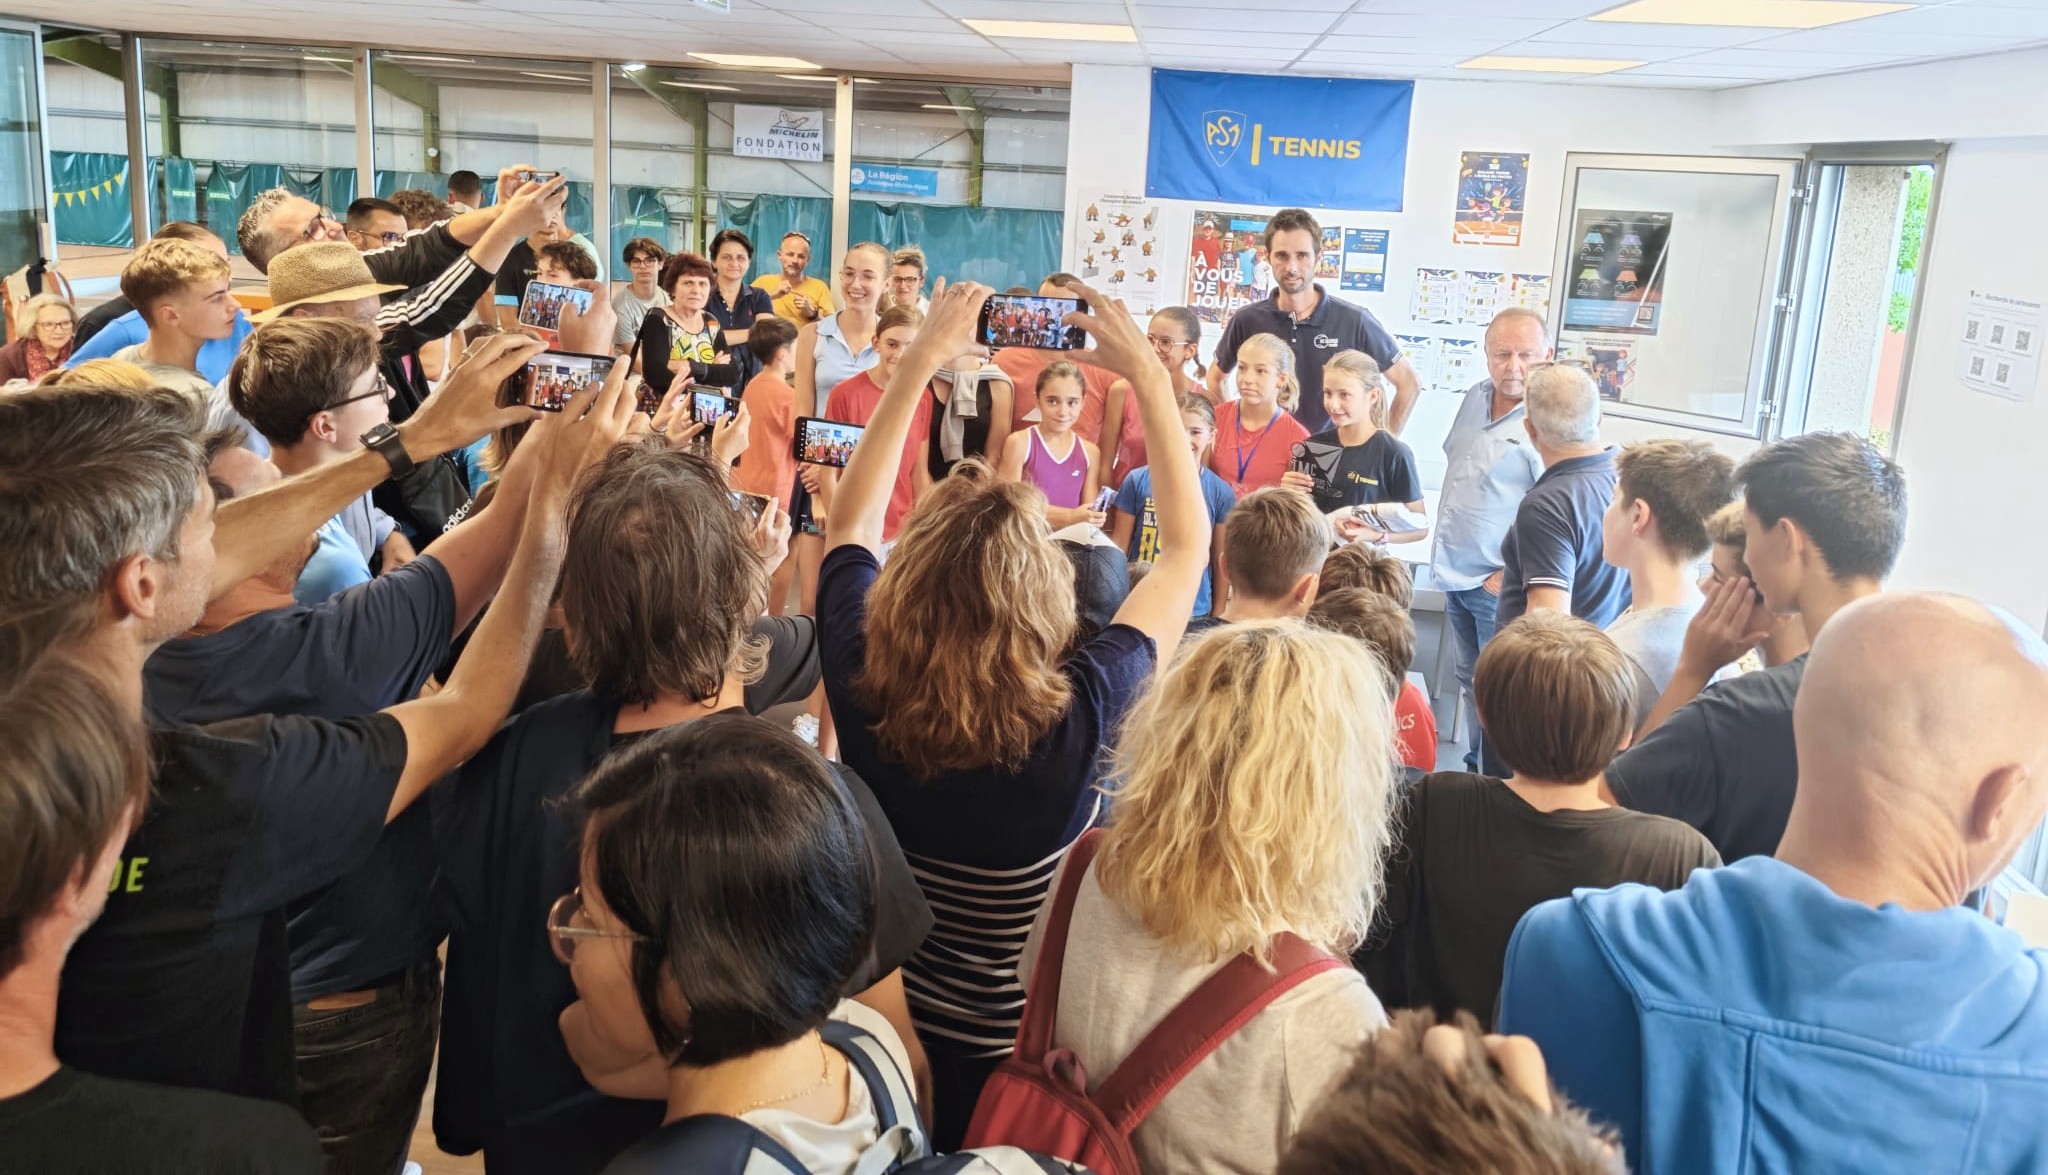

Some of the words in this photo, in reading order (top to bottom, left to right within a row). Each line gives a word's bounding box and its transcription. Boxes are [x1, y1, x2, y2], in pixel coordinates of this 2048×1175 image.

[736, 136, 821, 152] FONDATION
[1269, 136, 1361, 160] TENNIS
[868, 170, 878, 180] La
[879, 171, 909, 182] Région
[1195, 250, 1208, 267] À
[1195, 267, 1244, 283] VOUS
[1193, 280, 1217, 295] DE
